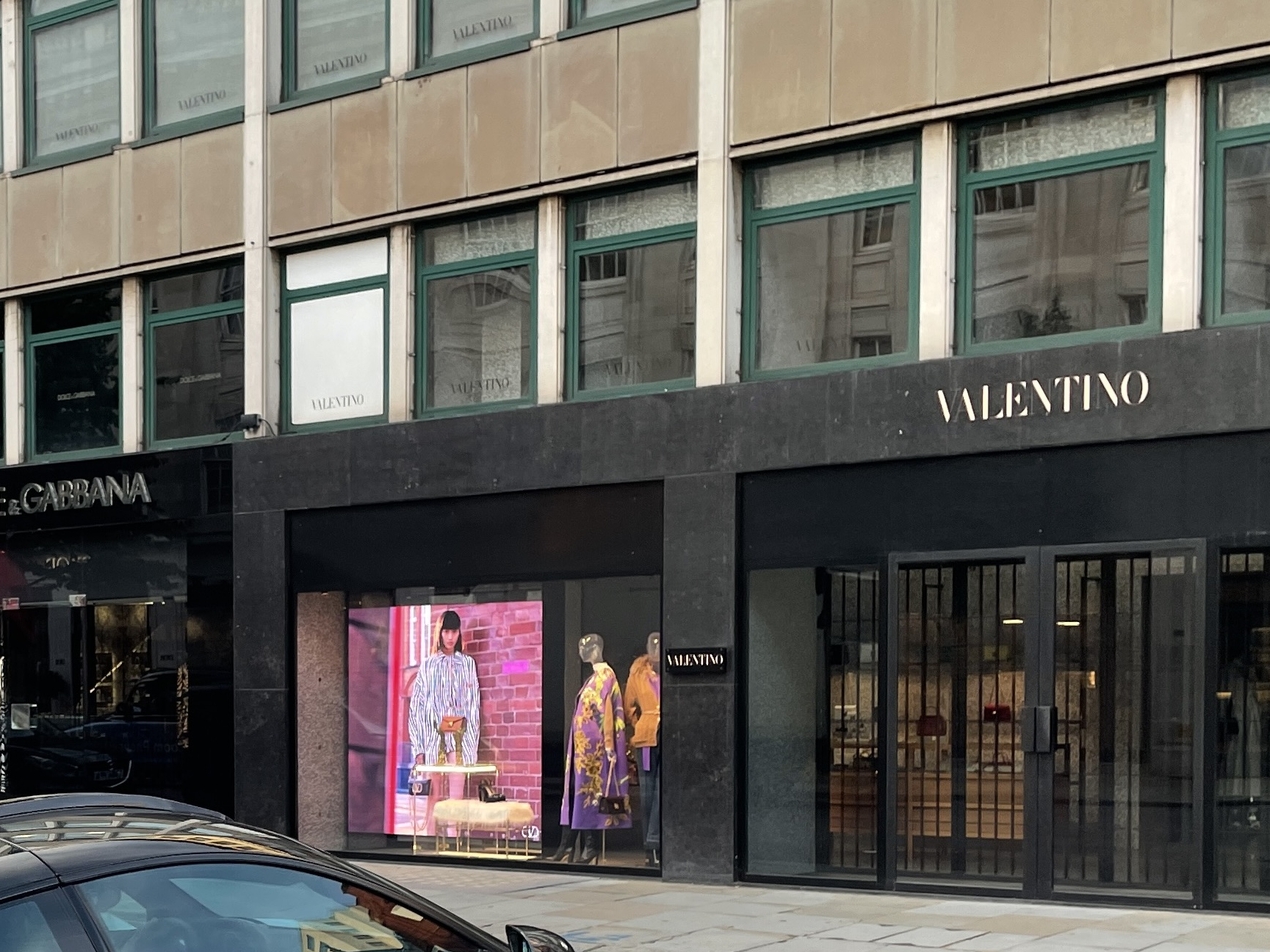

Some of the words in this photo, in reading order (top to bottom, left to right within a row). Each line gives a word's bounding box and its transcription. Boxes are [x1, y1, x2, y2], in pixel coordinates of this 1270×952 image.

[453, 15, 512, 40] VALENTINO
[314, 53, 367, 76] VALENTINO
[178, 89, 227, 111] VALENTINO
[55, 123, 99, 142] VALENTINO
[451, 377, 511, 394] VALENTINO
[311, 393, 365, 411] VALENTINO
[937, 370, 1150, 424] VALENTINO
[667, 653, 724, 667] VALENTINO
